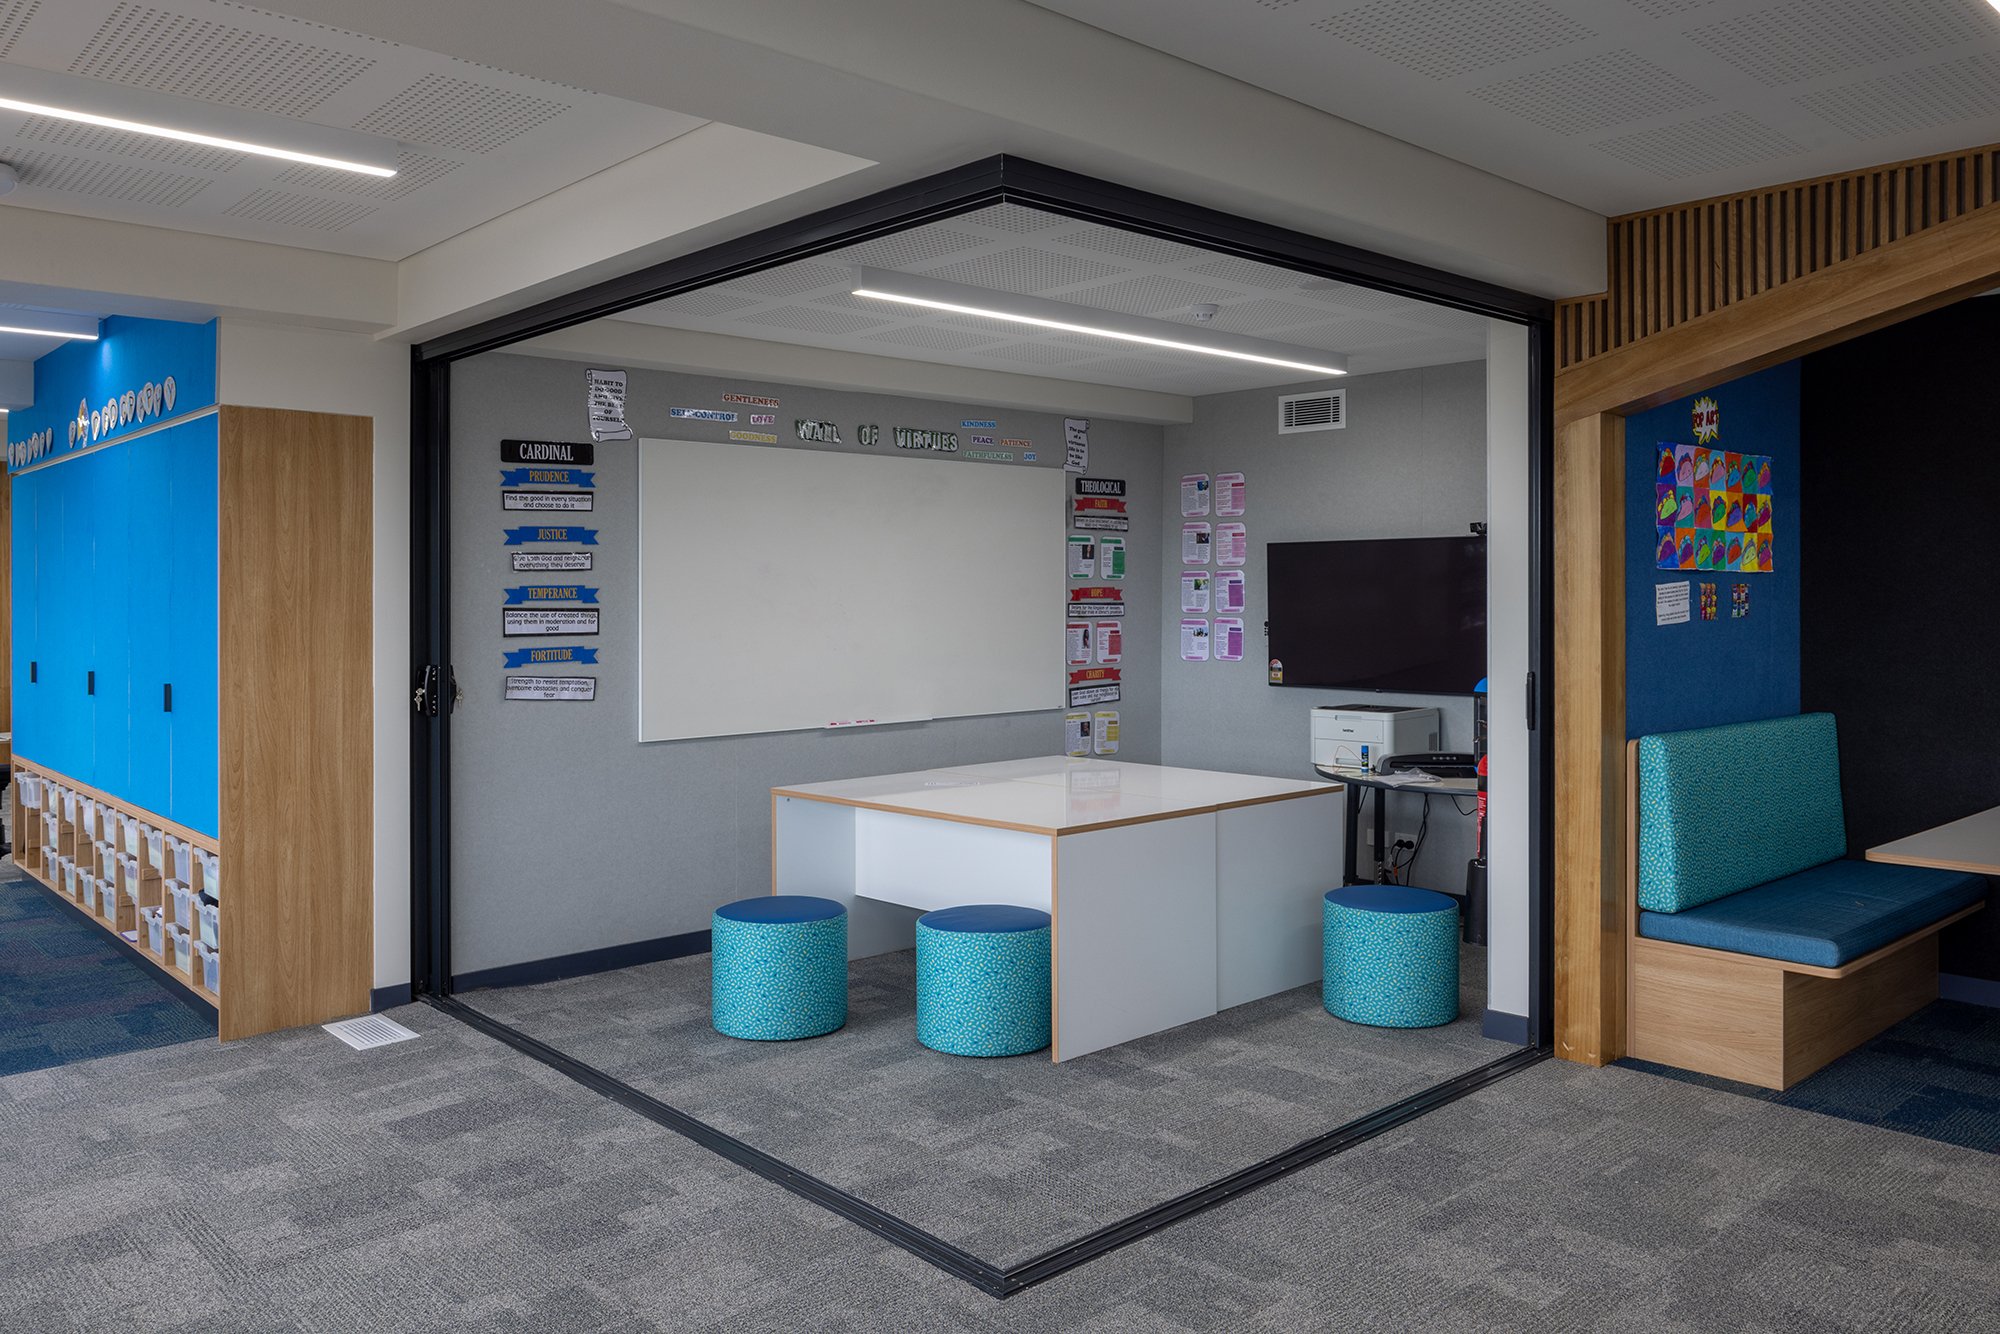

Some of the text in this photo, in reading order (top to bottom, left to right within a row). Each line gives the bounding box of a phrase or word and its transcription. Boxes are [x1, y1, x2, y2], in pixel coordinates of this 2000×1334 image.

[752, 416, 774, 424] LOVE
[858, 425, 879, 446] OF
[894, 426, 959, 452] VIRTUES
[972, 436, 993, 444] PEACE
[520, 443, 574, 461] CARDINAL
[529, 470, 569, 482] PRUDENCE
[1080, 480, 1121, 494] THEOLOGICAL
[538, 529, 568, 540] JUSTICE
[528, 588, 578, 599] TEMPERANCE
[531, 649, 573, 662] FORTITUDE
